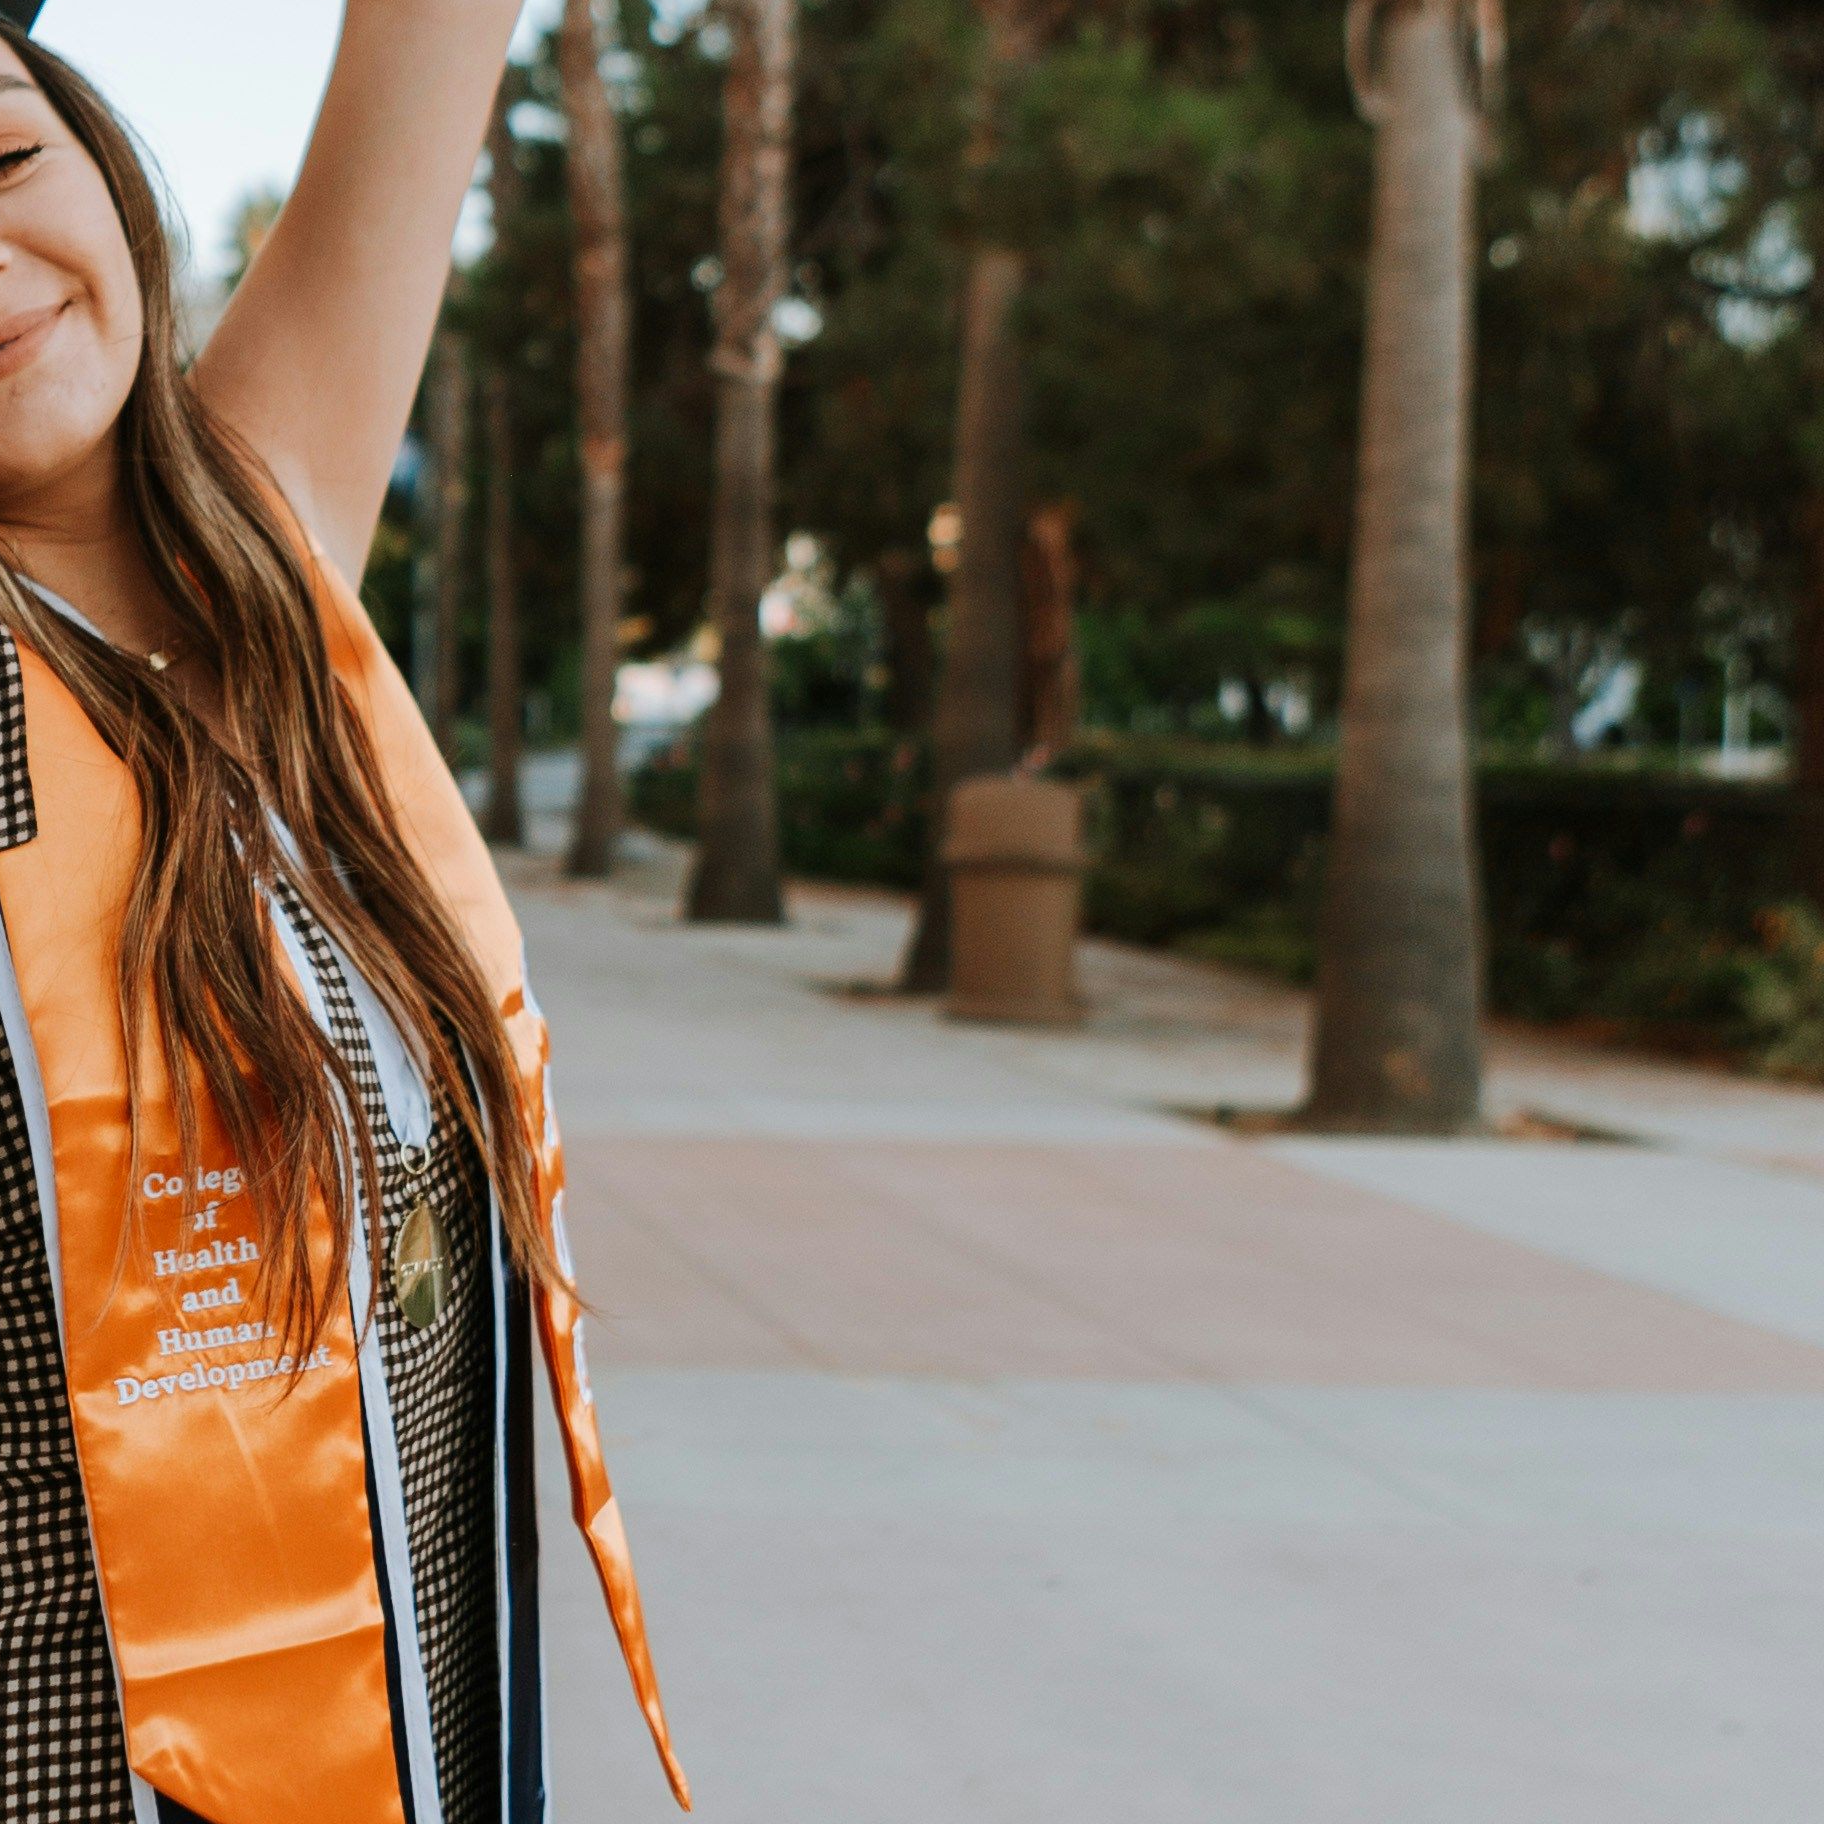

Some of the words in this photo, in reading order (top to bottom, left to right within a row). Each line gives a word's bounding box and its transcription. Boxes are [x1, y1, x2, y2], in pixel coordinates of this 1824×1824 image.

[143, 1166, 246, 1199] Coleg
[153, 1237, 259, 1276] Health
[181, 1278, 242, 1313] and
[157, 1321, 276, 1356] Human
